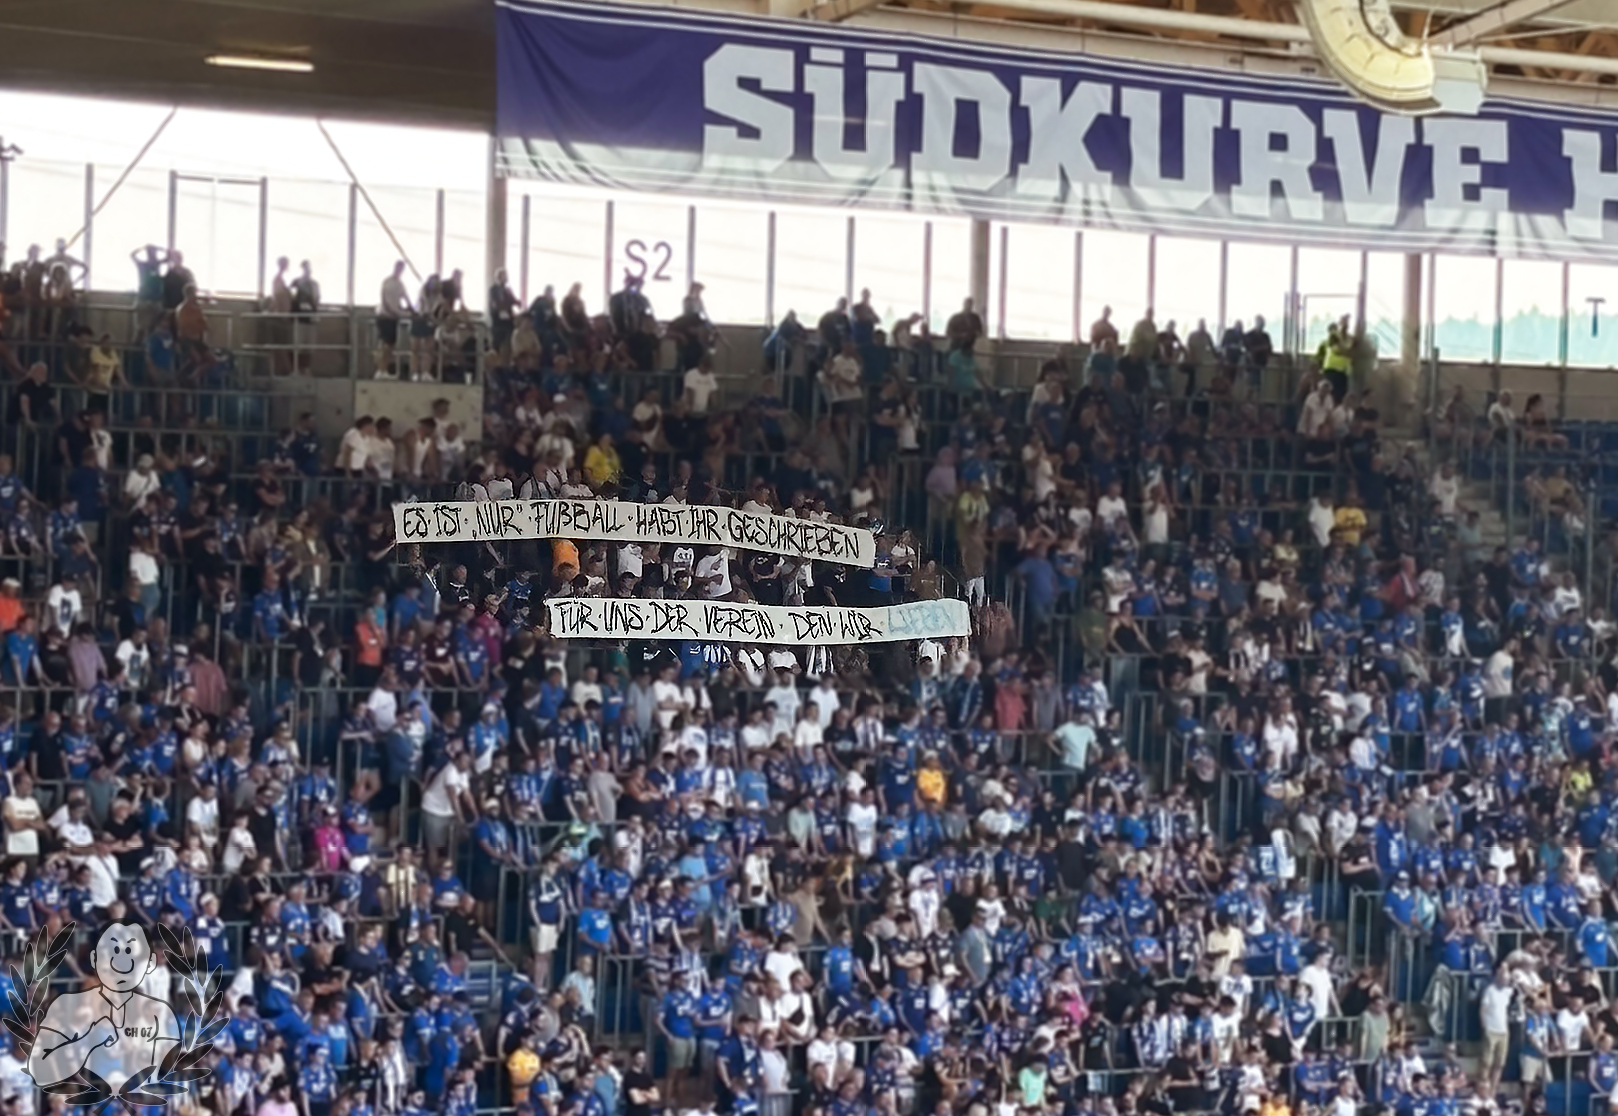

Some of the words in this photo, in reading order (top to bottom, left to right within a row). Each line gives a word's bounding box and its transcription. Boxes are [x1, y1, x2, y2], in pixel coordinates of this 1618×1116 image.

[702, 43, 1508, 230] SÜDKURVE
[624, 239, 672, 282] S2
[403, 507, 428, 538] ES
[433, 503, 461, 537] IST
[636, 505, 685, 537] HABT
[687, 507, 722, 541] IHR
[727, 511, 860, 559] GESCHRIEBEN
[554, 600, 597, 634] FÜR
[603, 602, 644, 634] UNS
[650, 601, 700, 637] DER
[703, 605, 776, 640] VEREIN
[788, 612, 833, 640] DEN
[839, 610, 883, 641] WIR
